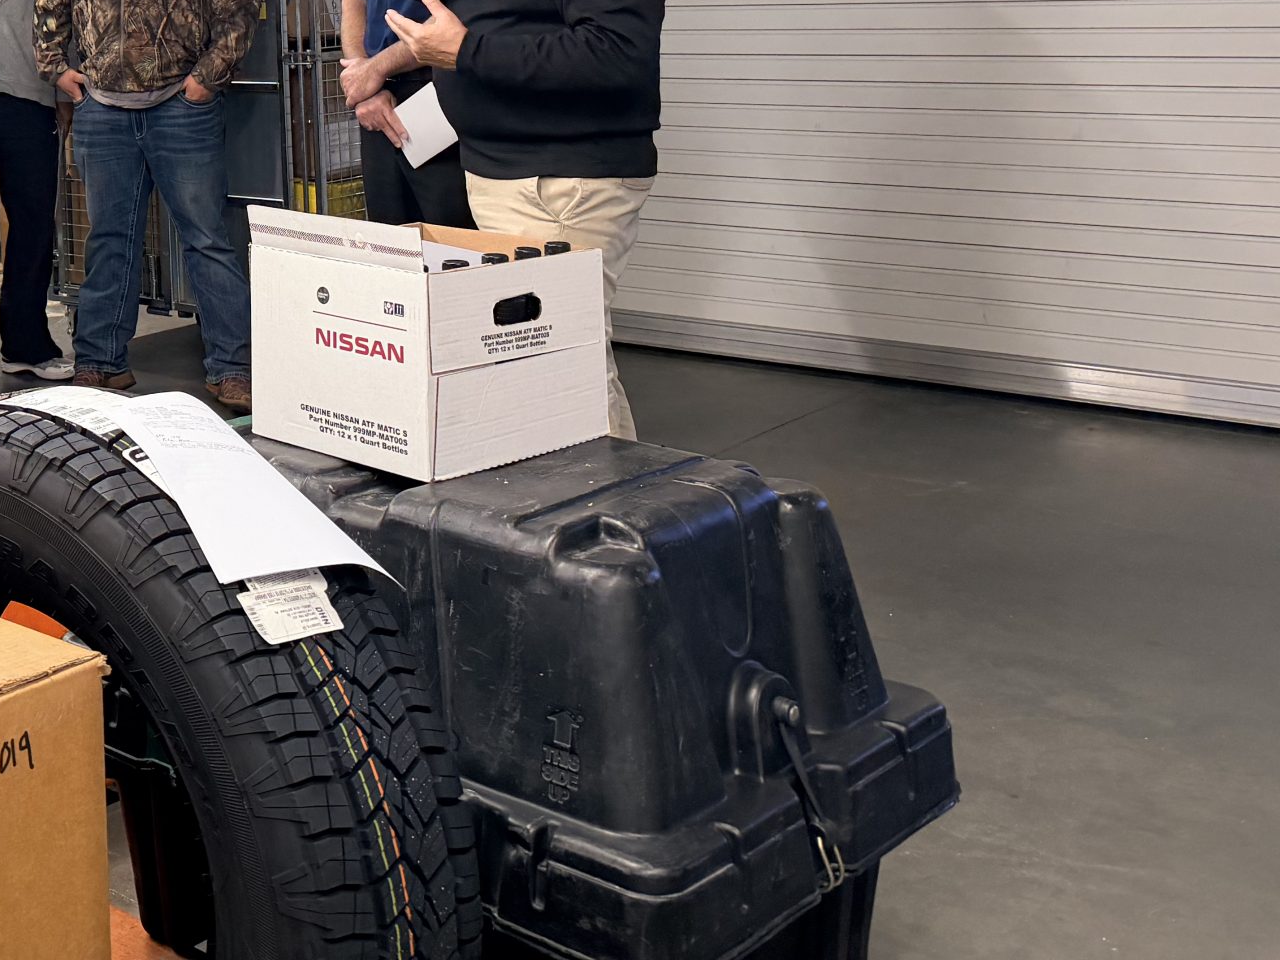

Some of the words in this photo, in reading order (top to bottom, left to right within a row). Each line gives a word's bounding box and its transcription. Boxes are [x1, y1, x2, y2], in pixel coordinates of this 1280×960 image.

[316, 328, 404, 364] NISSAN
[480, 333, 503, 342] GENUINE
[300, 404, 331, 418] GENUINE
[333, 412, 360, 425] NISSAN
[361, 419, 375, 428] ATF
[377, 424, 400, 435] MATIC
[309, 414, 323, 424] Part
[325, 418, 351, 431] Number
[353, 426, 408, 446] 999MP-MAT00S
[319, 426, 335, 436] QTY:
[337, 430, 346, 438] 12
[360, 437, 380, 448] Quart
[382, 442, 408, 455] Bottles
[541, 763, 579, 792] SIDE
[548, 783, 570, 804] UP
